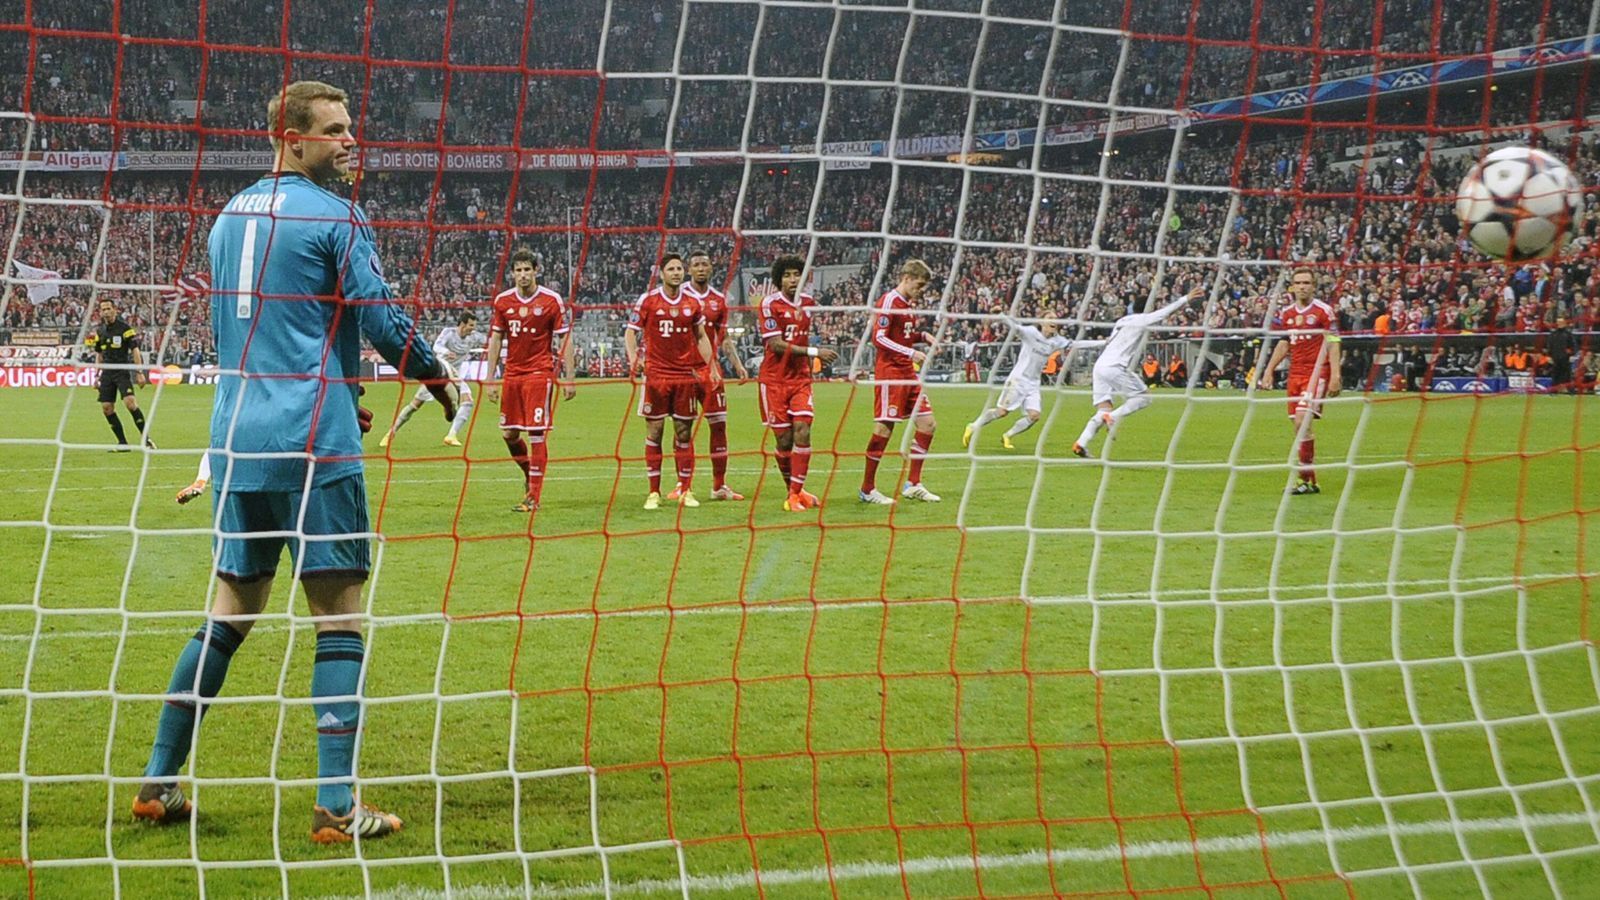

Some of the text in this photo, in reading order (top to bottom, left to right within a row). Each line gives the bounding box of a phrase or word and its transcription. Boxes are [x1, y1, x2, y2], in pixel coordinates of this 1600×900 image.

[45, 152, 103, 169] Allgäu
[383, 153, 503, 169] DIE ROTEN BOMBERS
[231, 193, 287, 212] NEUER
[236, 219, 258, 319] 1
[8, 367, 98, 388] UniCredi
[533, 407, 544, 423] 8
